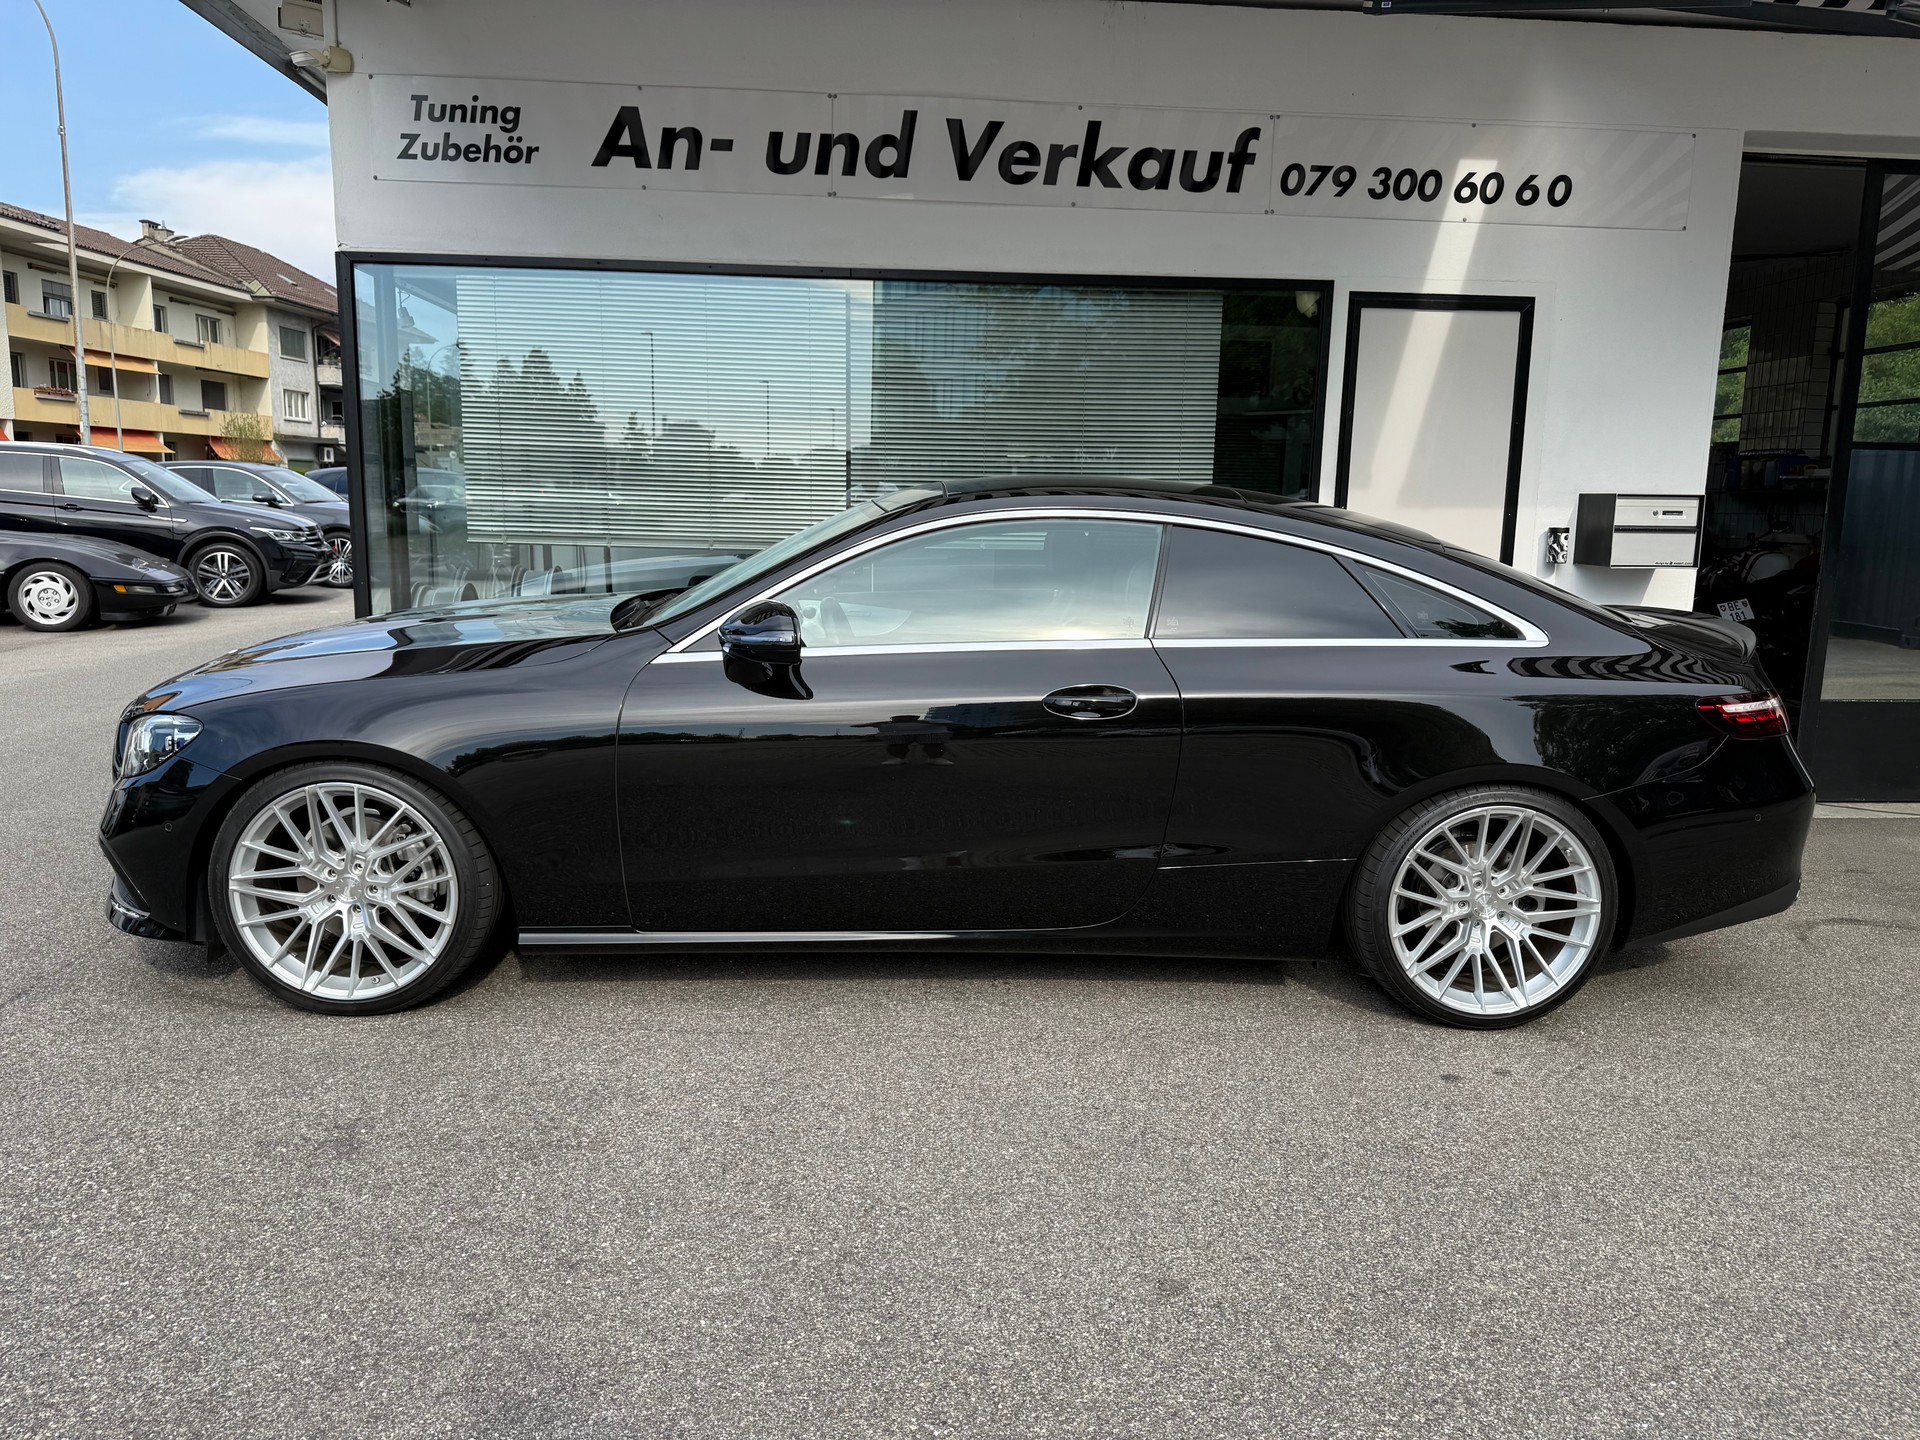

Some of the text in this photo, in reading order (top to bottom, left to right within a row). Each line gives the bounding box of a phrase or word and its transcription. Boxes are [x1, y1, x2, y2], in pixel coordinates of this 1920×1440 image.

[410, 94, 522, 134] Tuning
[396, 132, 540, 165] Zubehör
[590, 105, 1262, 194] An- und Verkauf
[1279, 162, 1357, 198] 079
[1367, 166, 1443, 203] 300
[1453, 171, 1505, 205] 60
[1727, 601, 1741, 612] BE
